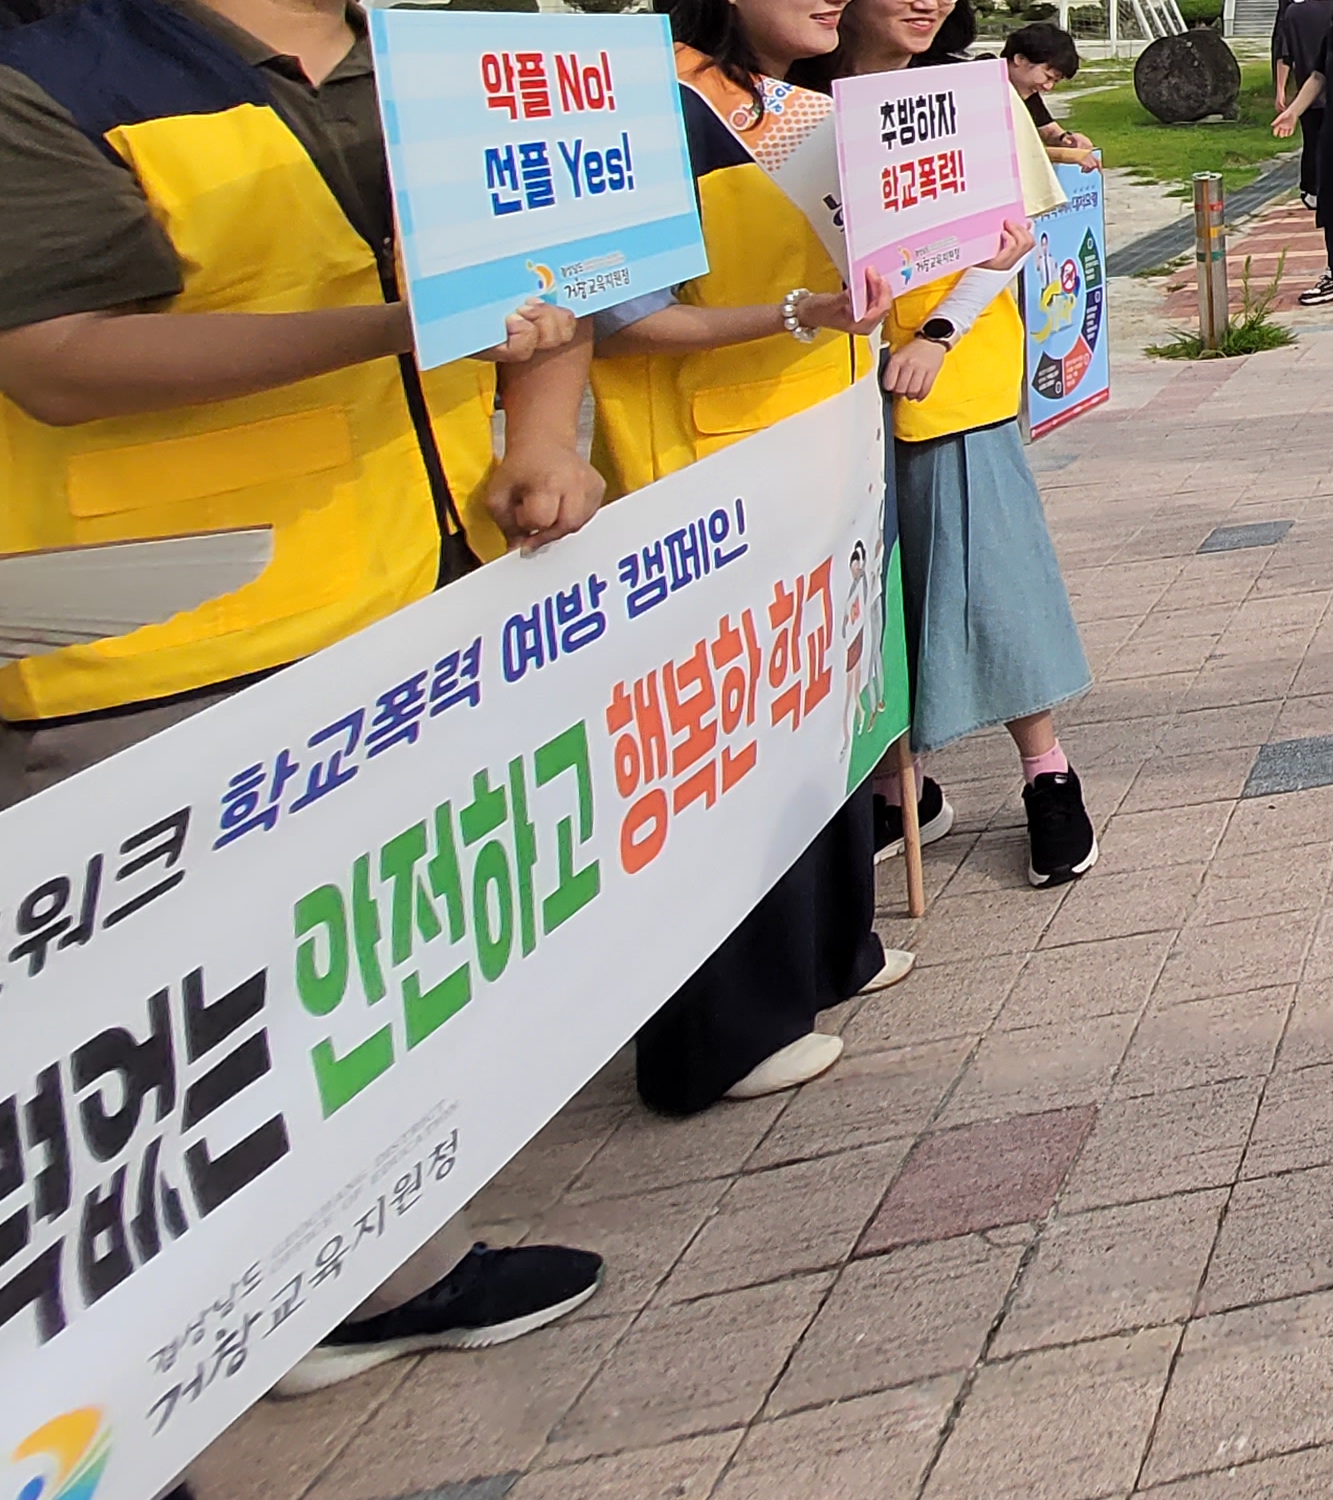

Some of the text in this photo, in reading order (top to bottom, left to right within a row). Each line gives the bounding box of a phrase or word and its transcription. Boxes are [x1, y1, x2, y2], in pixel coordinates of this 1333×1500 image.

[481, 51, 616, 120] 악플 No!
[880, 90, 957, 150] 추방하자
[484, 131, 635, 217] 선플 Yes!
[881, 149, 966, 213] 학교폭력!
[8, 498, 749, 978] 워크 학교폭력 예방 캠페인
[294, 718, 602, 1120] 안전하고
[605, 607, 763, 876] 행복한
[767, 554, 834, 733] 학교
[145, 1128, 459, 1438] 거창교육지원청
[147, 1261, 264, 1374] 경상남도
